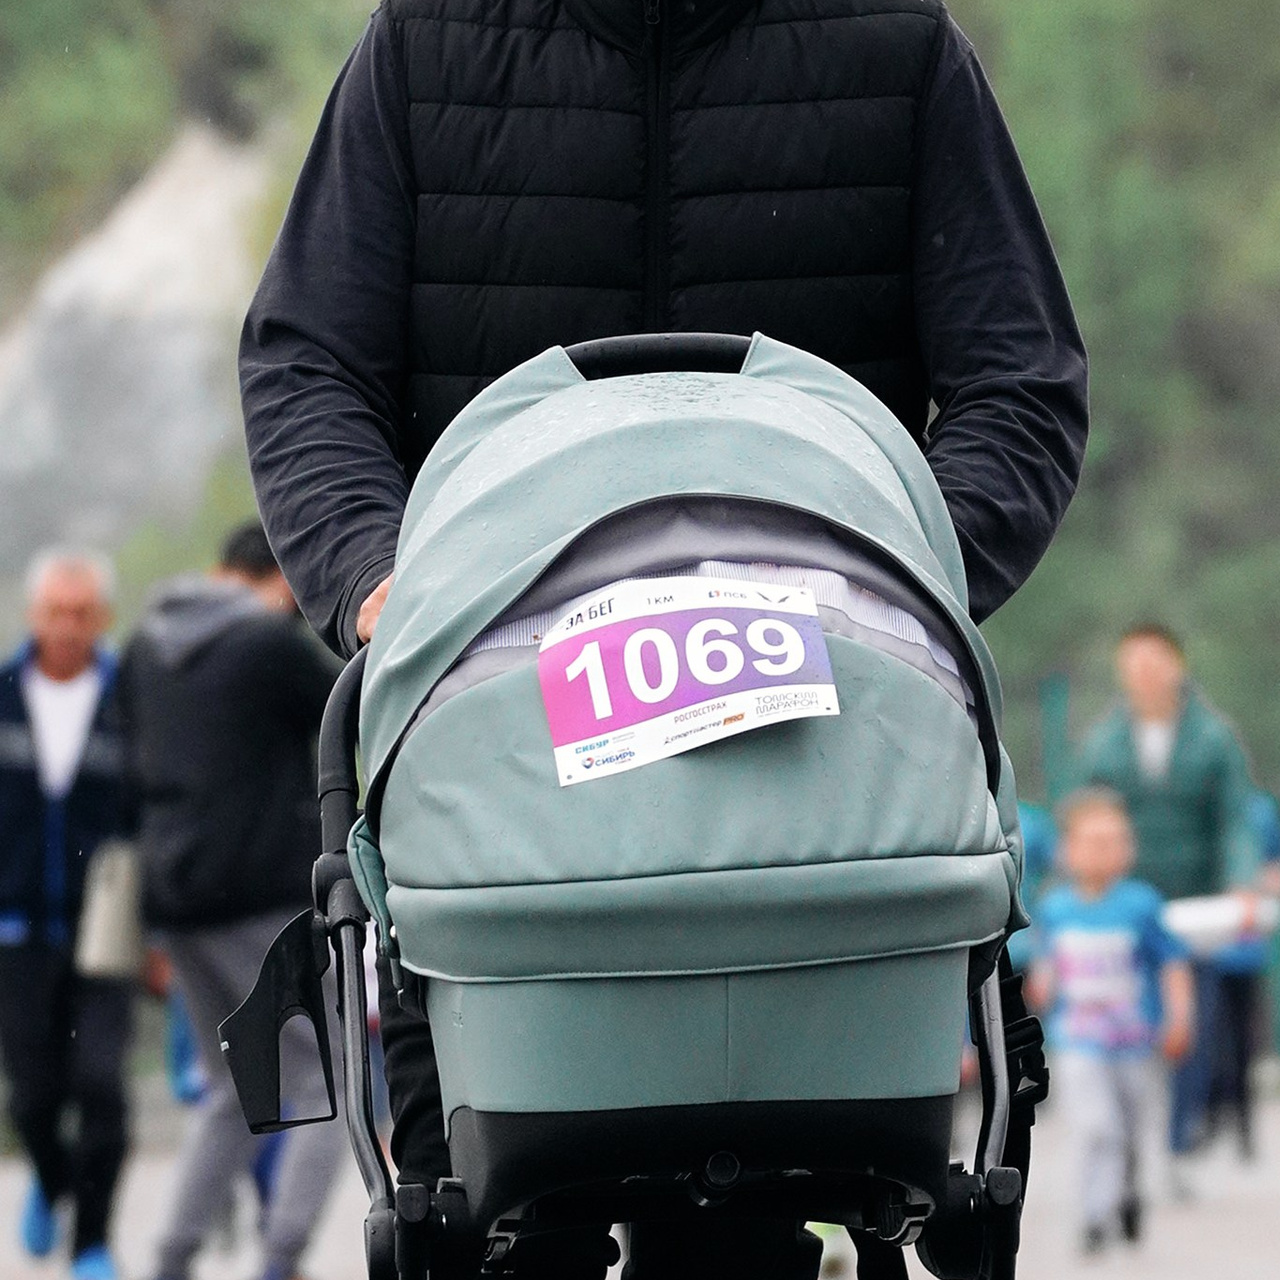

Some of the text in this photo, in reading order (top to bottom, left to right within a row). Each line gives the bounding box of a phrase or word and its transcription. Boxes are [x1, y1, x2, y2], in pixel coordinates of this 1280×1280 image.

[565, 618, 805, 720] 1069
[575, 739, 609, 754] СИБУР
[595, 750, 636, 766] СИБИРЬ
